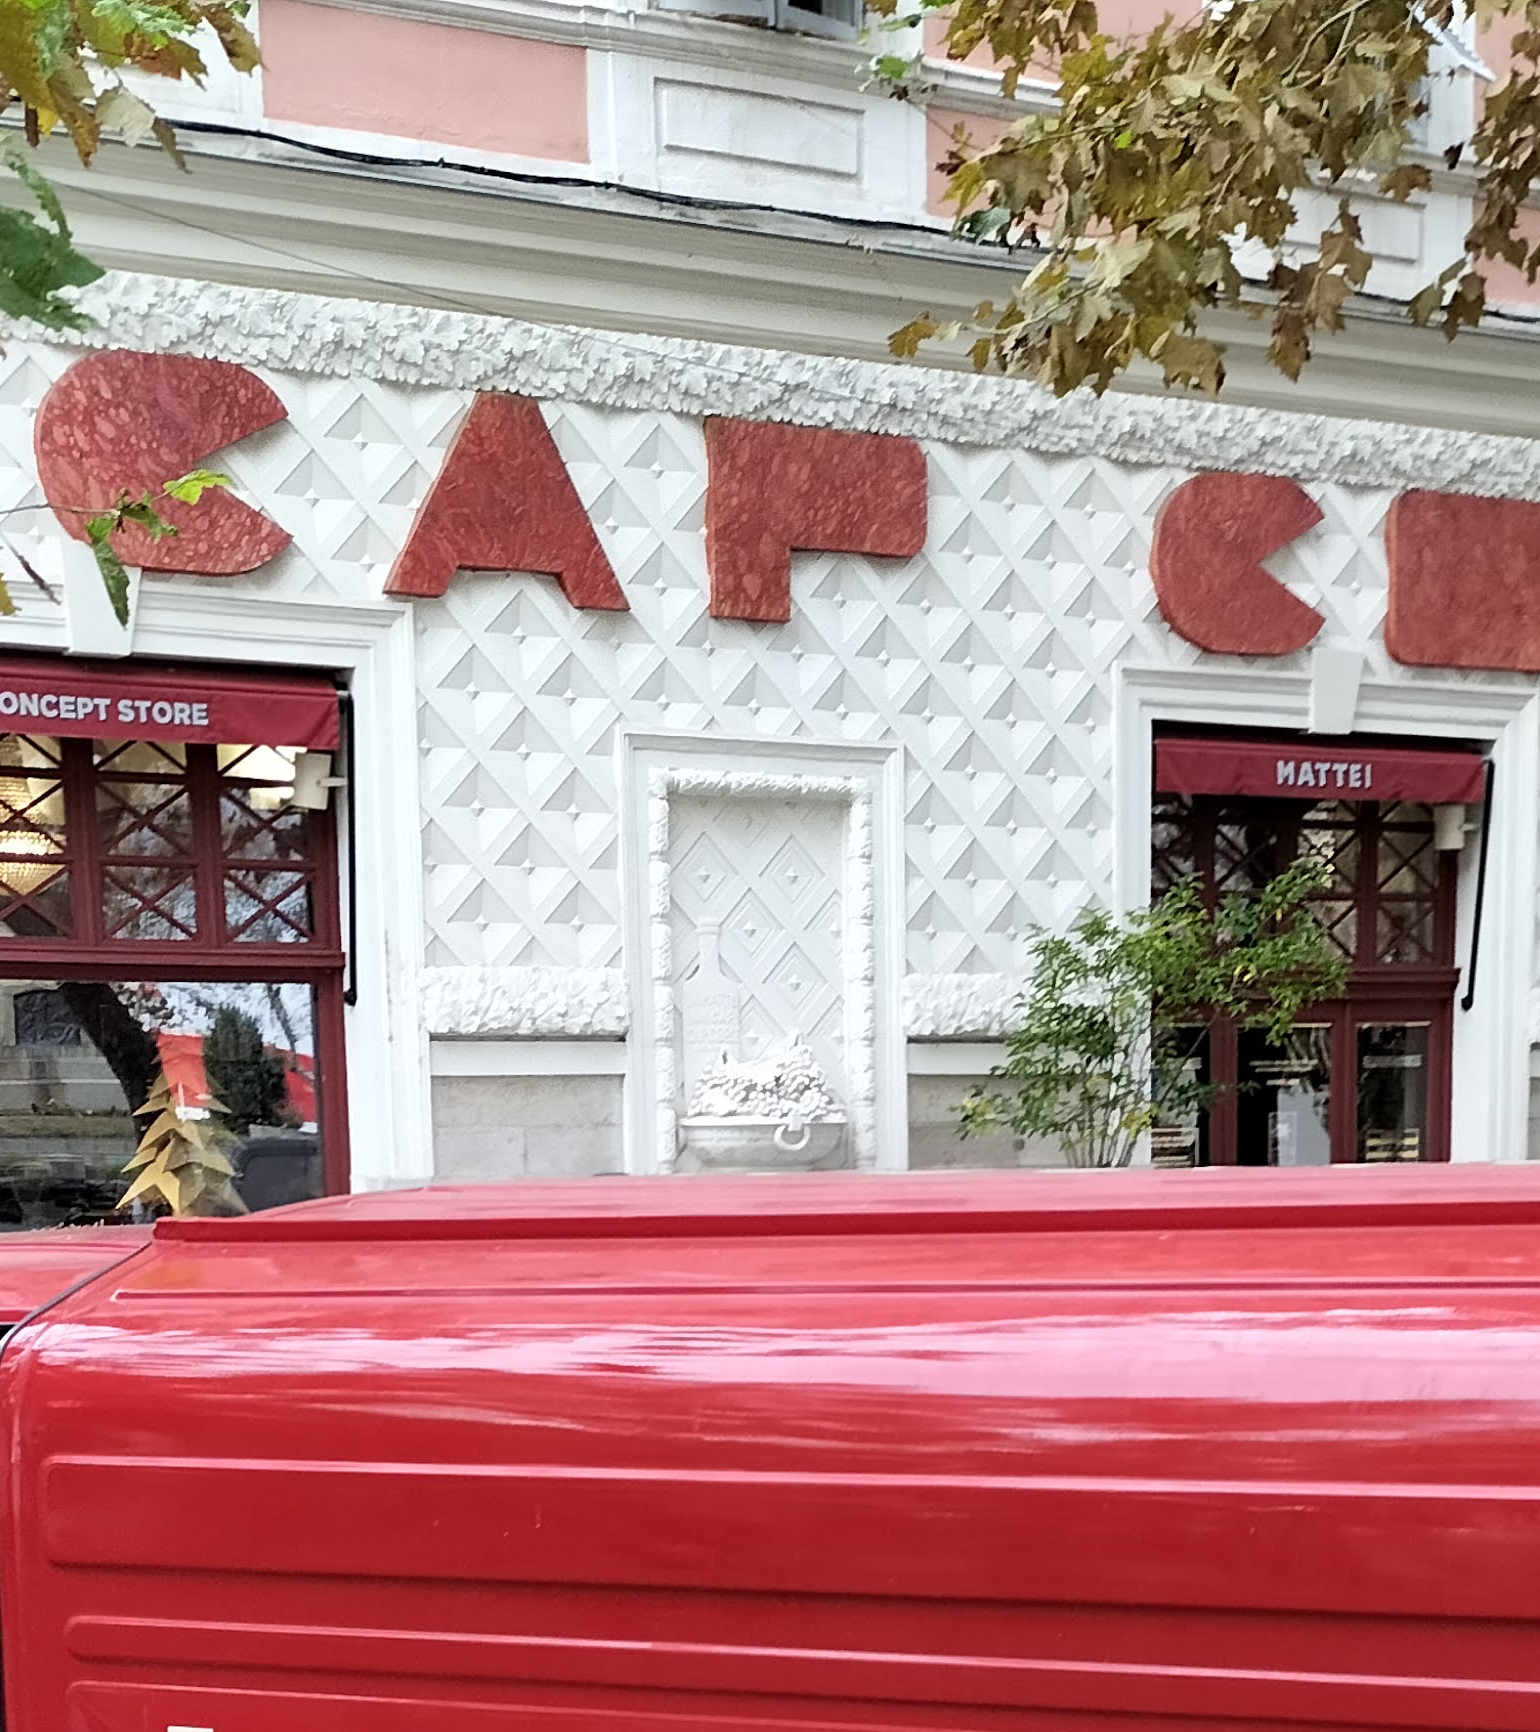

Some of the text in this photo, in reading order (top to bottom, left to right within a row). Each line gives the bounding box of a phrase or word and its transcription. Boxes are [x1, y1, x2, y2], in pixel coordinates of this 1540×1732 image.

[33, 348, 929, 624] CAP
[117, 699, 209, 726] STORE
[1276, 759, 1373, 789] MATTEI
